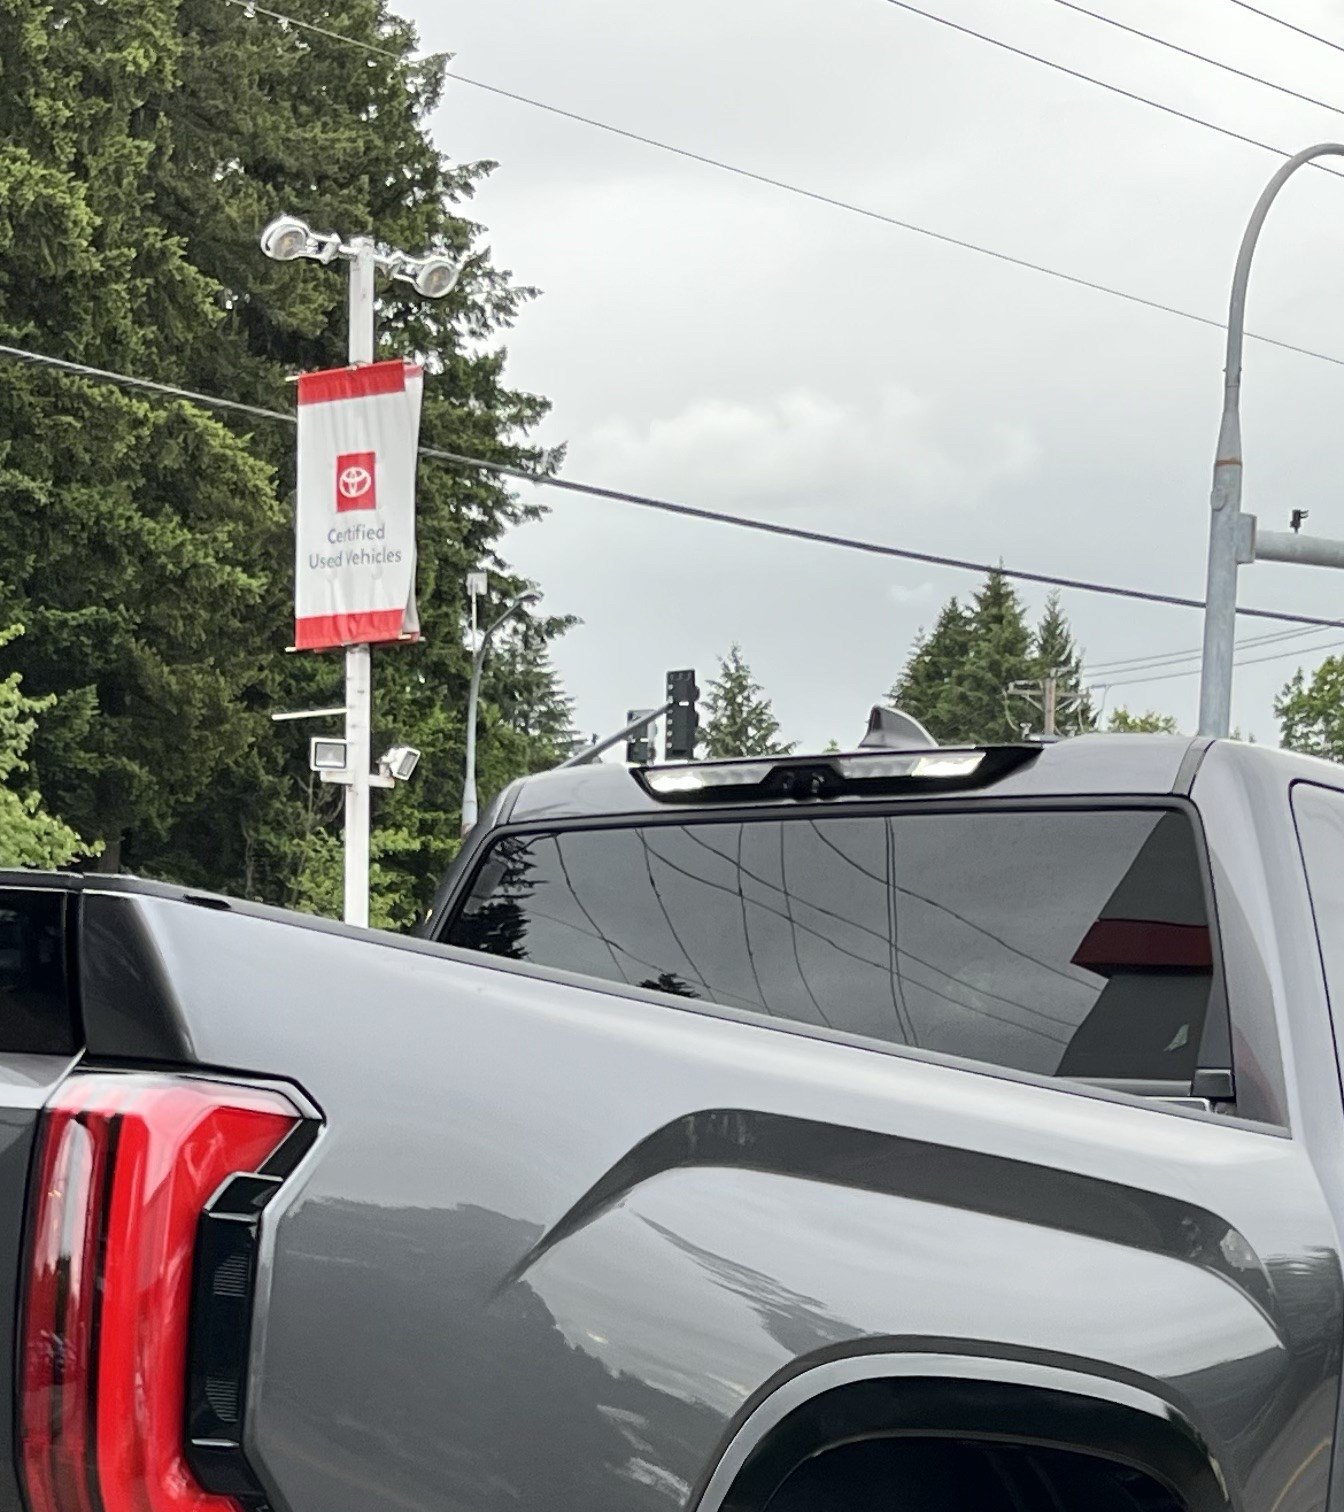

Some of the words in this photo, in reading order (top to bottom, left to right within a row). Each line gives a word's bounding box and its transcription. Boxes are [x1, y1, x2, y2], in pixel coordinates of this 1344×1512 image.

[327, 523, 386, 545] Certified
[308, 550, 343, 570] Used
[346, 547, 402, 567] Vehicles
